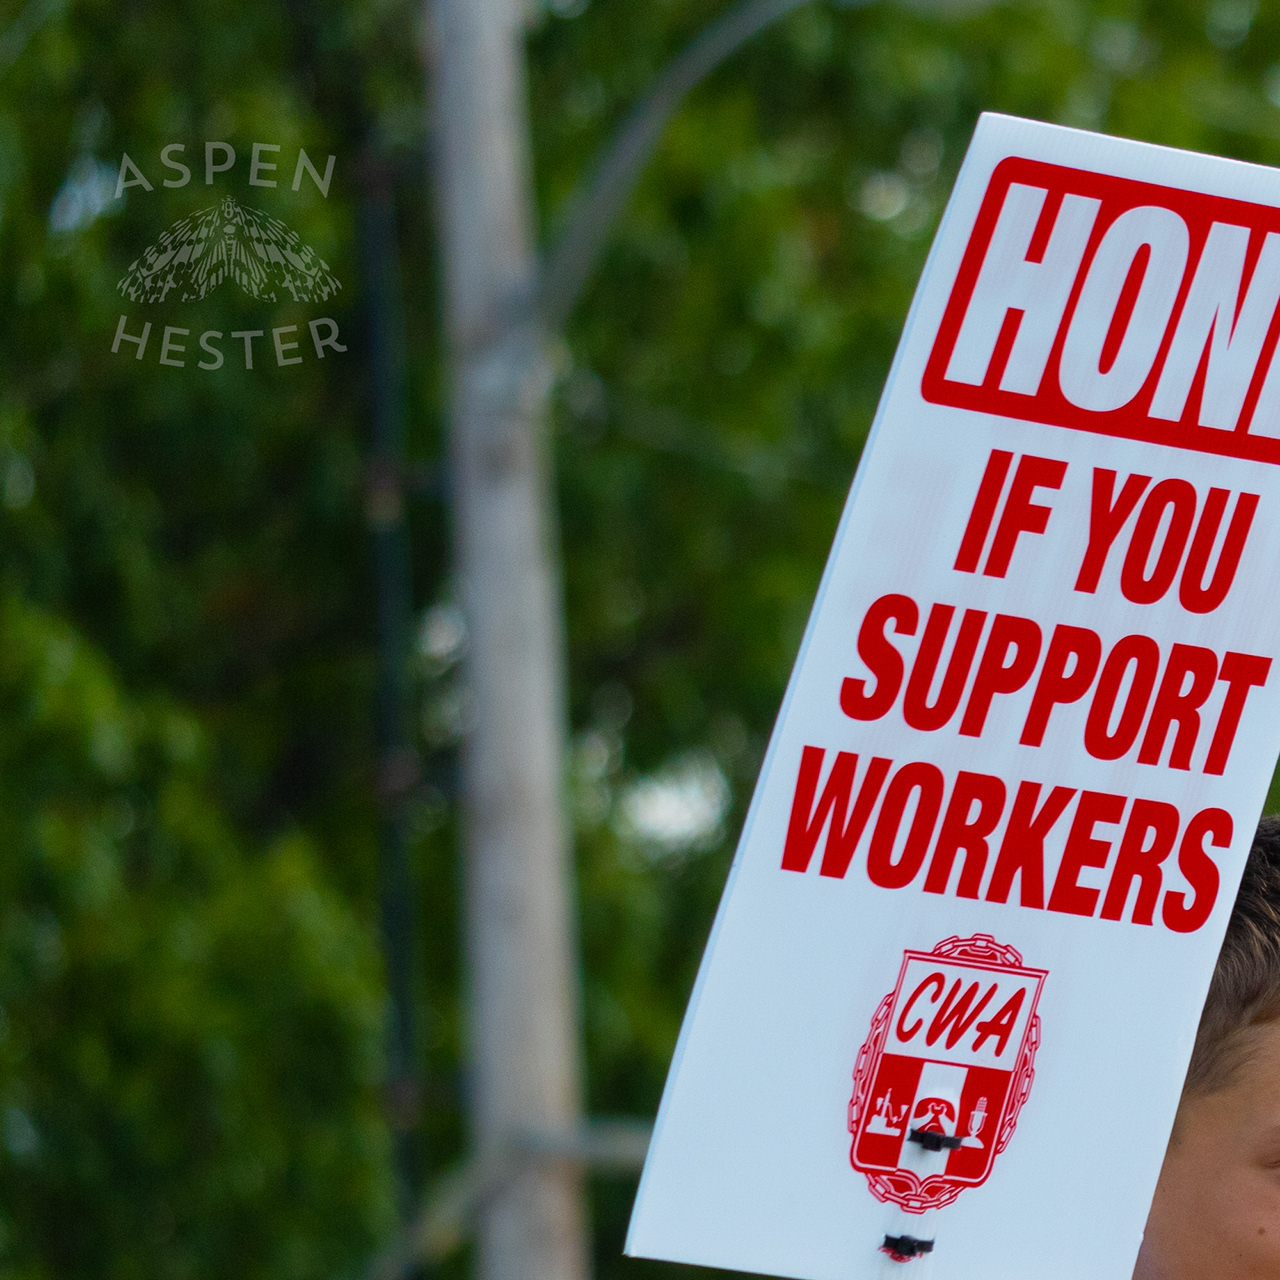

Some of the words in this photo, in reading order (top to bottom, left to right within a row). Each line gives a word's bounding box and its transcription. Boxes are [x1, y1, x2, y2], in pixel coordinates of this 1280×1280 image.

[953, 448, 1069, 579] IF
[1073, 466, 1261, 615] YOU
[838, 592, 1273, 776] SUPPORT
[780, 745, 1235, 933] WORKERS
[895, 971, 1027, 1058] CWA
